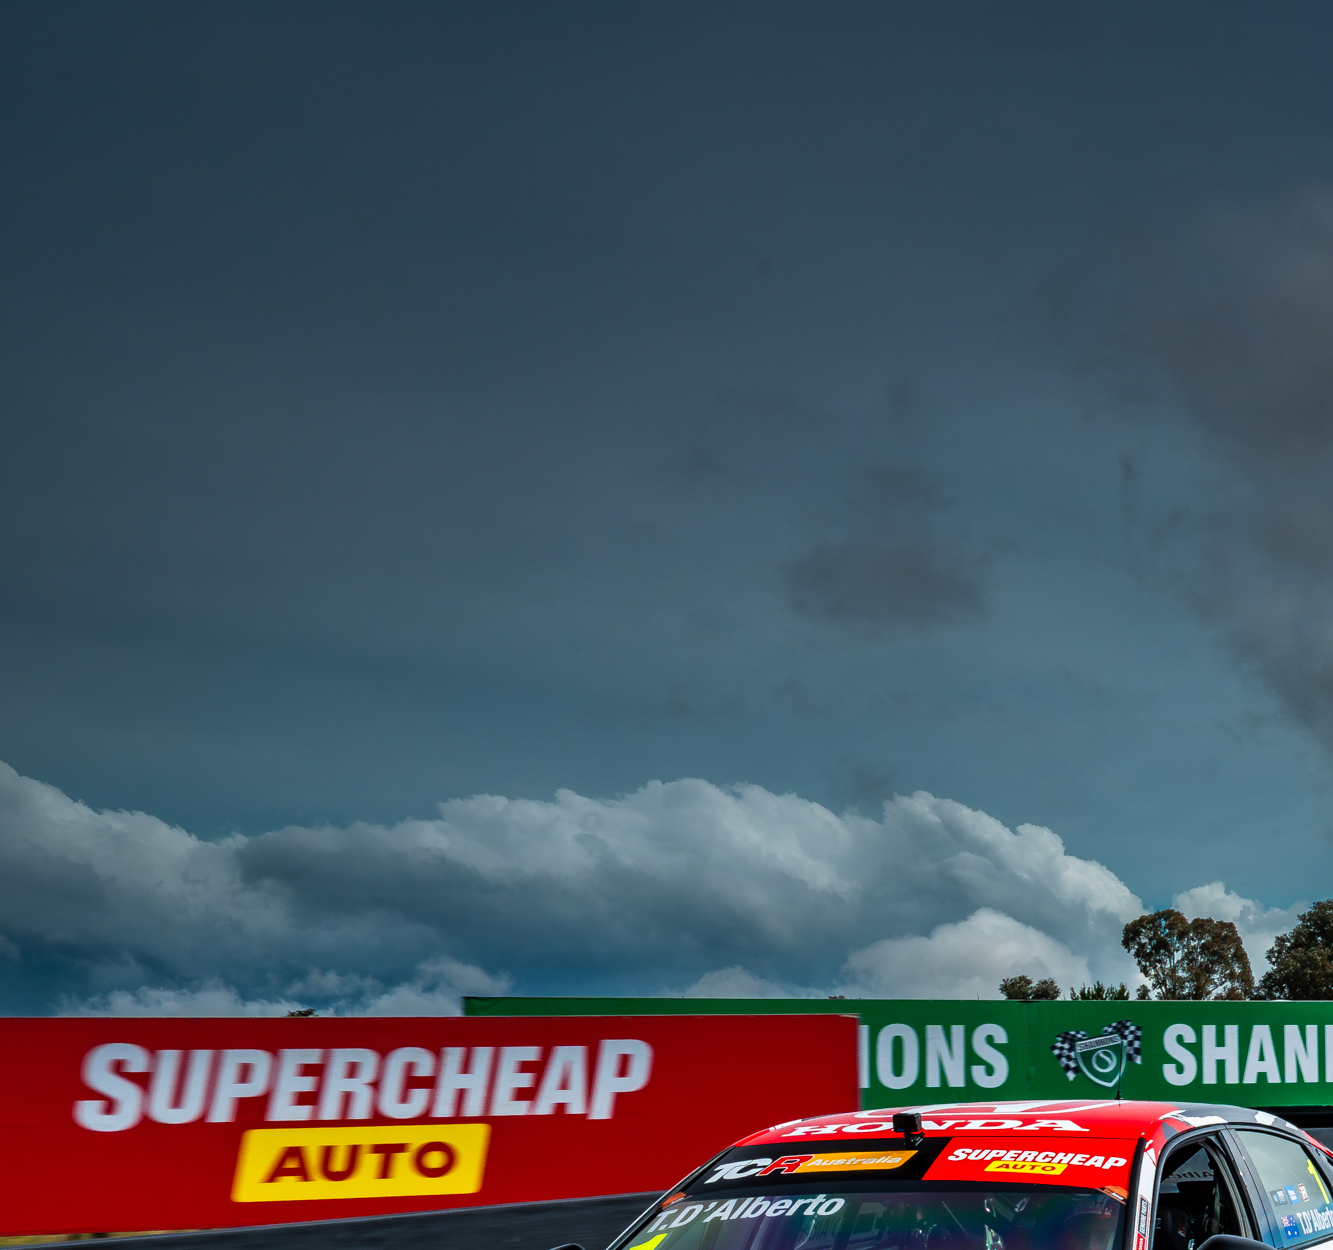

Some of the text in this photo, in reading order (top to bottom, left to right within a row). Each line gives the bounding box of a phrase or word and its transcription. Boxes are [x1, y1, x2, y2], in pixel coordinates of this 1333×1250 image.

[74, 1039, 655, 1133] SUPERCHEAP
[781, 1119, 1090, 1138] HONDA
[258, 1142, 458, 1185] AUTO
[704, 1155, 902, 1184] TCR Australia
[948, 1148, 1127, 1170] SUPERCHEAP
[995, 1163, 1056, 1173] AUTO
